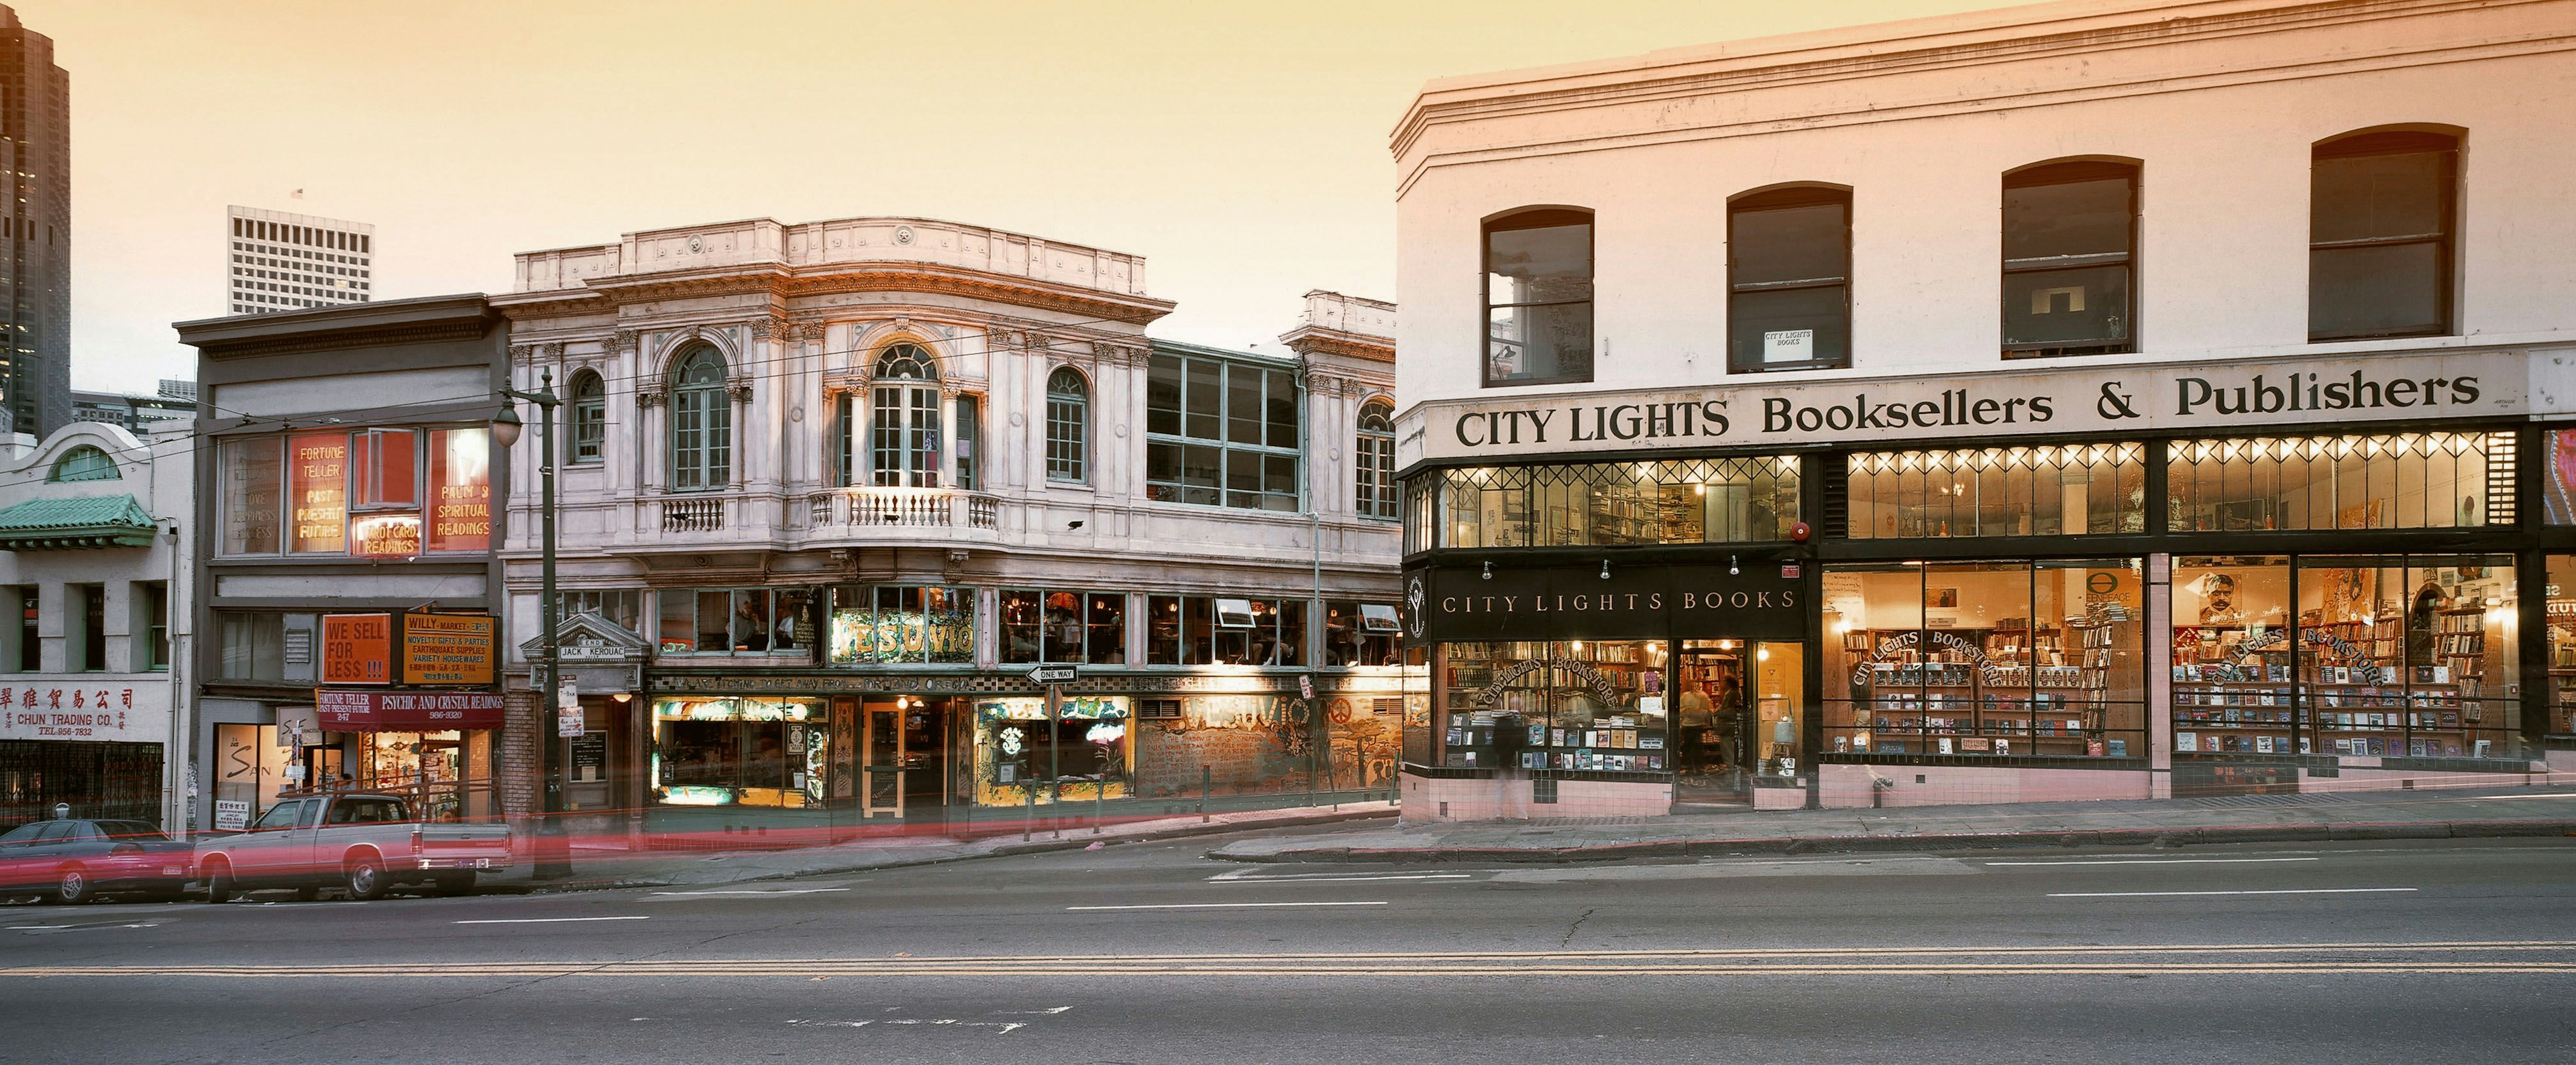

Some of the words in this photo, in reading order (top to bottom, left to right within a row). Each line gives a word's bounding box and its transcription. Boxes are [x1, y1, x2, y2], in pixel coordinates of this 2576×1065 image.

[1456, 408, 1552, 447] CITY
[1570, 400, 1729, 441] LIGHTS
[1762, 388, 2053, 433] Booksellers
[2097, 381, 2141, 421] &
[2176, 370, 2480, 416] Publishers
[301, 446, 345, 461] FORTUNE
[303, 465, 340, 478] TELLER
[307, 490, 334, 503] PAST
[441, 486, 473, 500] PALM
[297, 507, 343, 522] PRESENT
[438, 504, 489, 518] SPIRITUAL
[392, 525, 416, 539] CARD
[438, 522, 490, 536] READINGS
[365, 540, 415, 555] READINGS
[1443, 596, 1517, 613] CITY
[1536, 593, 1662, 612] LIGHTS
[1684, 590, 1794, 610] BOOKS
[409, 617, 437, 629] WILLY
[329, 623, 347, 639] WE
[354, 622, 384, 640] SELL
[465, 638, 490, 646] PARTIES
[328, 642, 353, 659] FOR
[413, 645, 455, 654] EARTHQUAKE
[457, 647, 485, 655] SUPPLIES
[562, 648, 582, 656] JACK
[413, 655, 441, 663] VARIETY
[443, 655, 484, 663] HOUSEWARES
[1854, 656, 1876, 687] CITY
[1872, 631, 1919, 662] LIGHTS
[1933, 631, 2002, 687] BOOKSTORE
[2232, 628, 2286, 661] LIGHTS
[2306, 628, 2385, 688] BOOKSTORE
[1482, 677, 1507, 706] CITY
[1502, 657, 1542, 683] LIGHTS
[1555, 657, 1619, 708] BOOKSTORE
[319, 693, 343, 704] FORTUNE
[345, 693, 370, 705] TELLER
[382, 695, 417, 711] PSYCHIC
[419, 696, 435, 710] AND
[437, 695, 470, 710] CRYSTAL
[471, 695, 504, 710] READINGS
[18, 714, 46, 725] CHUN
[52, 714, 93, 726] TRADING
[97, 715, 113, 726] CO.
[337, 713, 350, 722] 247
